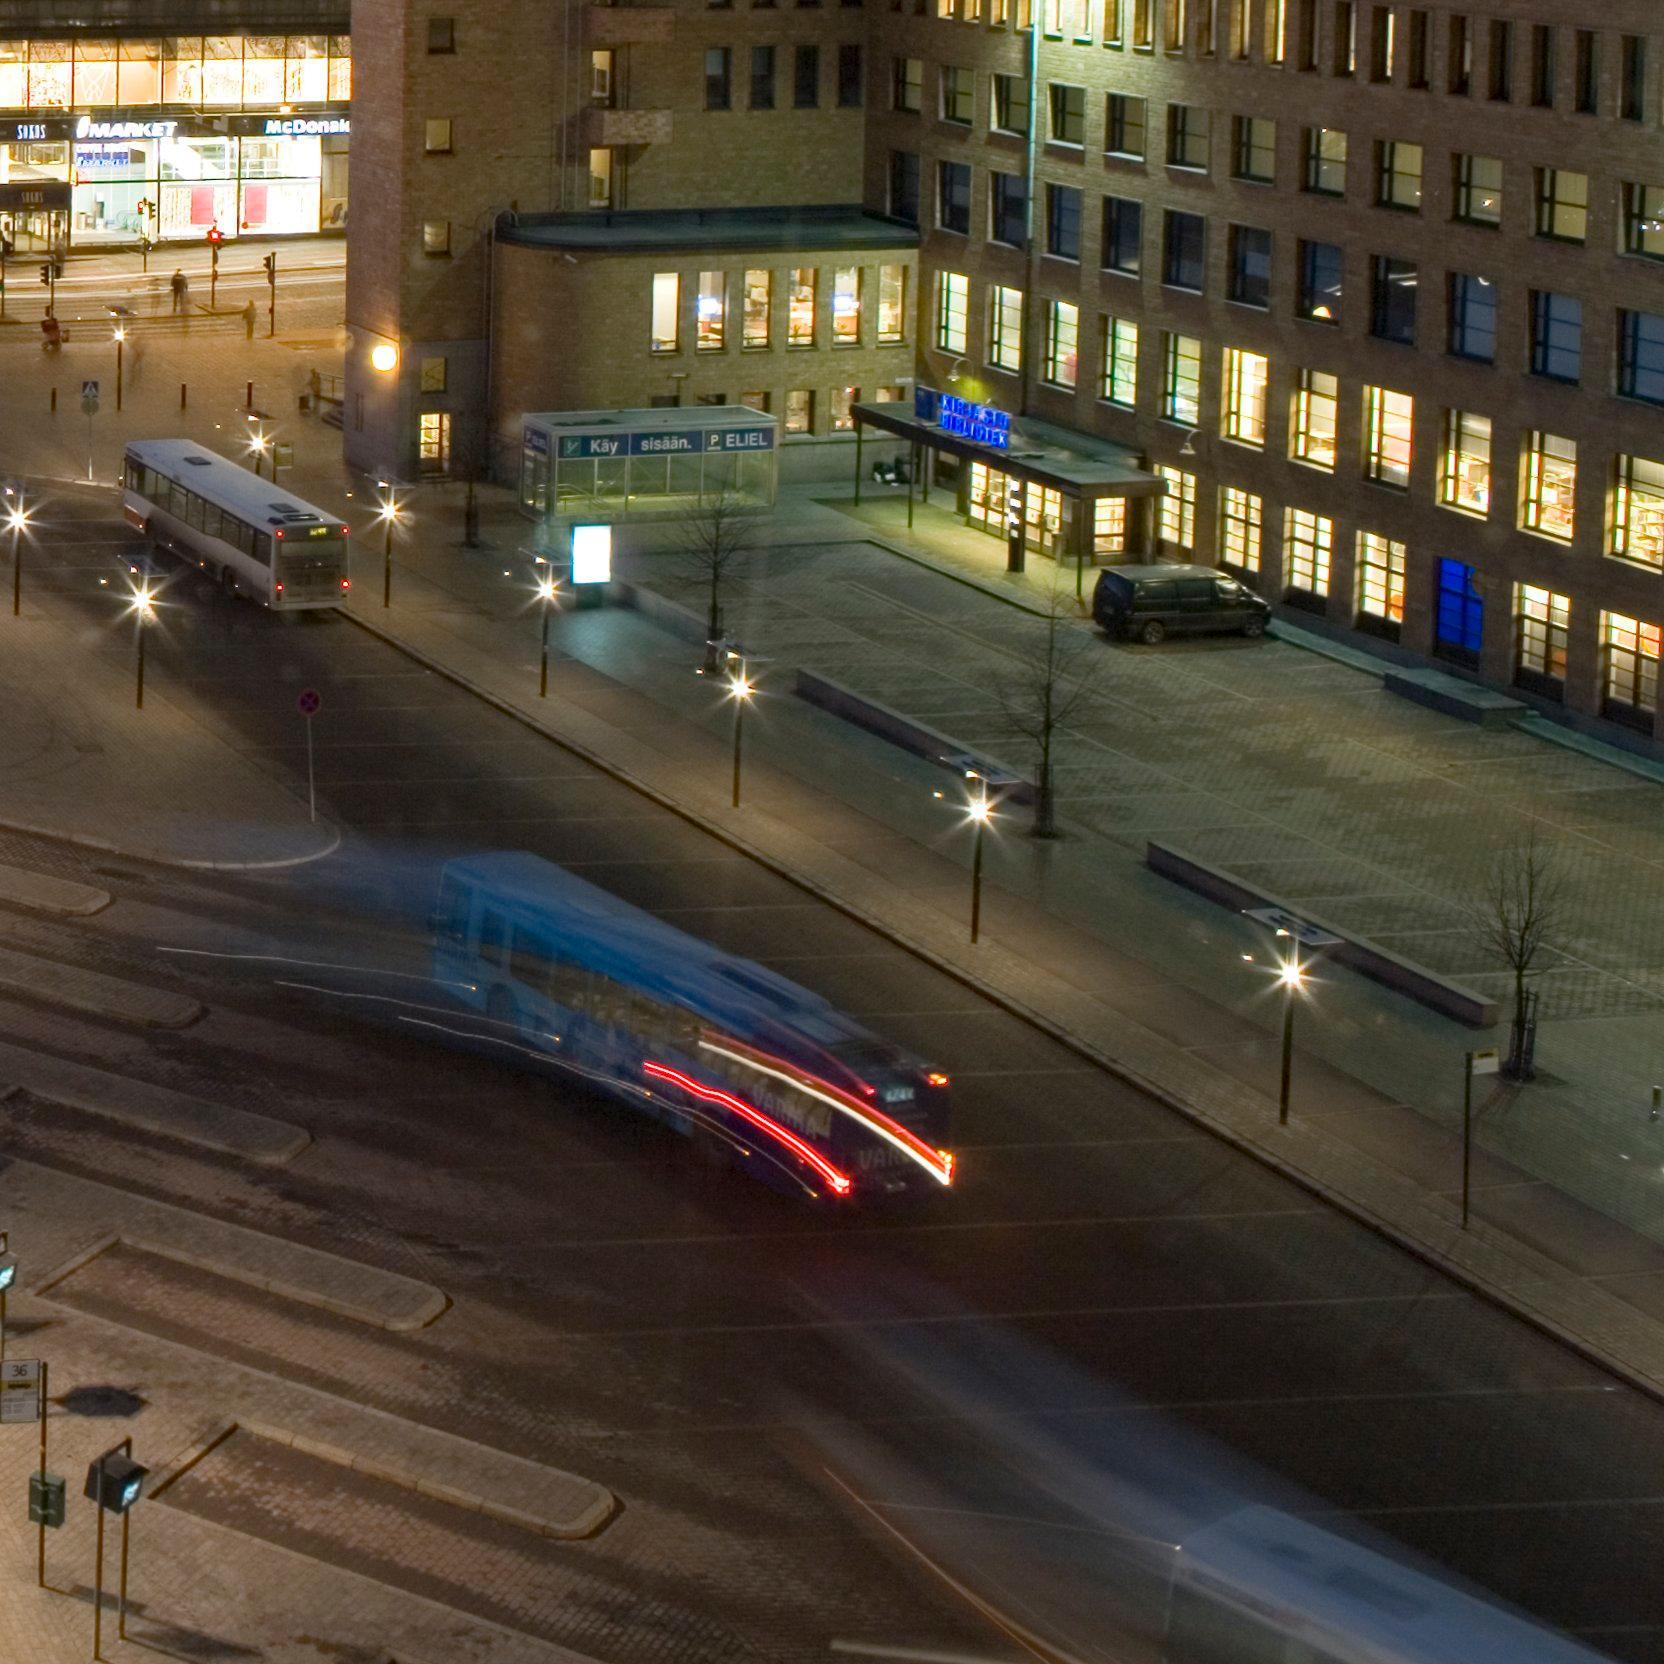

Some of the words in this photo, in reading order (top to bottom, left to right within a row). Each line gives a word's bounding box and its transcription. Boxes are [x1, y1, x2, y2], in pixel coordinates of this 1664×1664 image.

[590, 438, 619, 455] Käy
[641, 436, 693, 452] sisään.
[709, 435, 719, 446] P
[726, 432, 769, 448] ELIEL
[12, 1364, 28, 1377] 36
